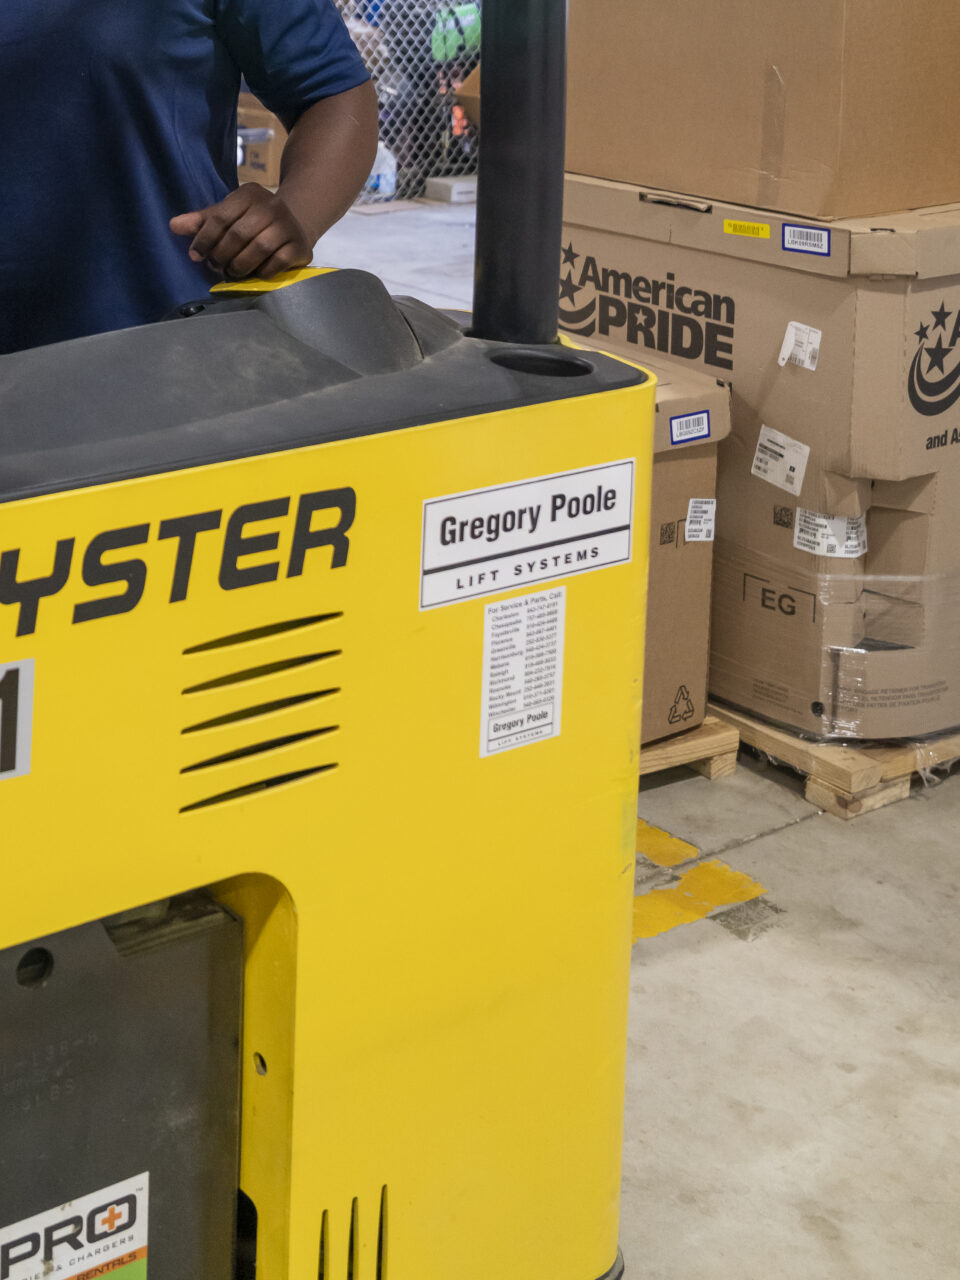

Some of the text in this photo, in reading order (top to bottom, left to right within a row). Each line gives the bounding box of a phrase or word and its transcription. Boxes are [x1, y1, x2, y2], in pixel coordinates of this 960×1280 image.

[578, 256, 735, 324] American
[599, 295, 734, 370] PRIDE
[926, 429, 948, 450] and
[440, 485, 617, 546] Gregory Poole
[456, 547, 599, 589] LIFT SYSTEMS
[761, 587, 796, 615] EG
[493, 710, 548, 733] Gregory Poole
[69, 1234, 134, 1266] CHARGERS
[77, 1251, 137, 1280] RENTALS
